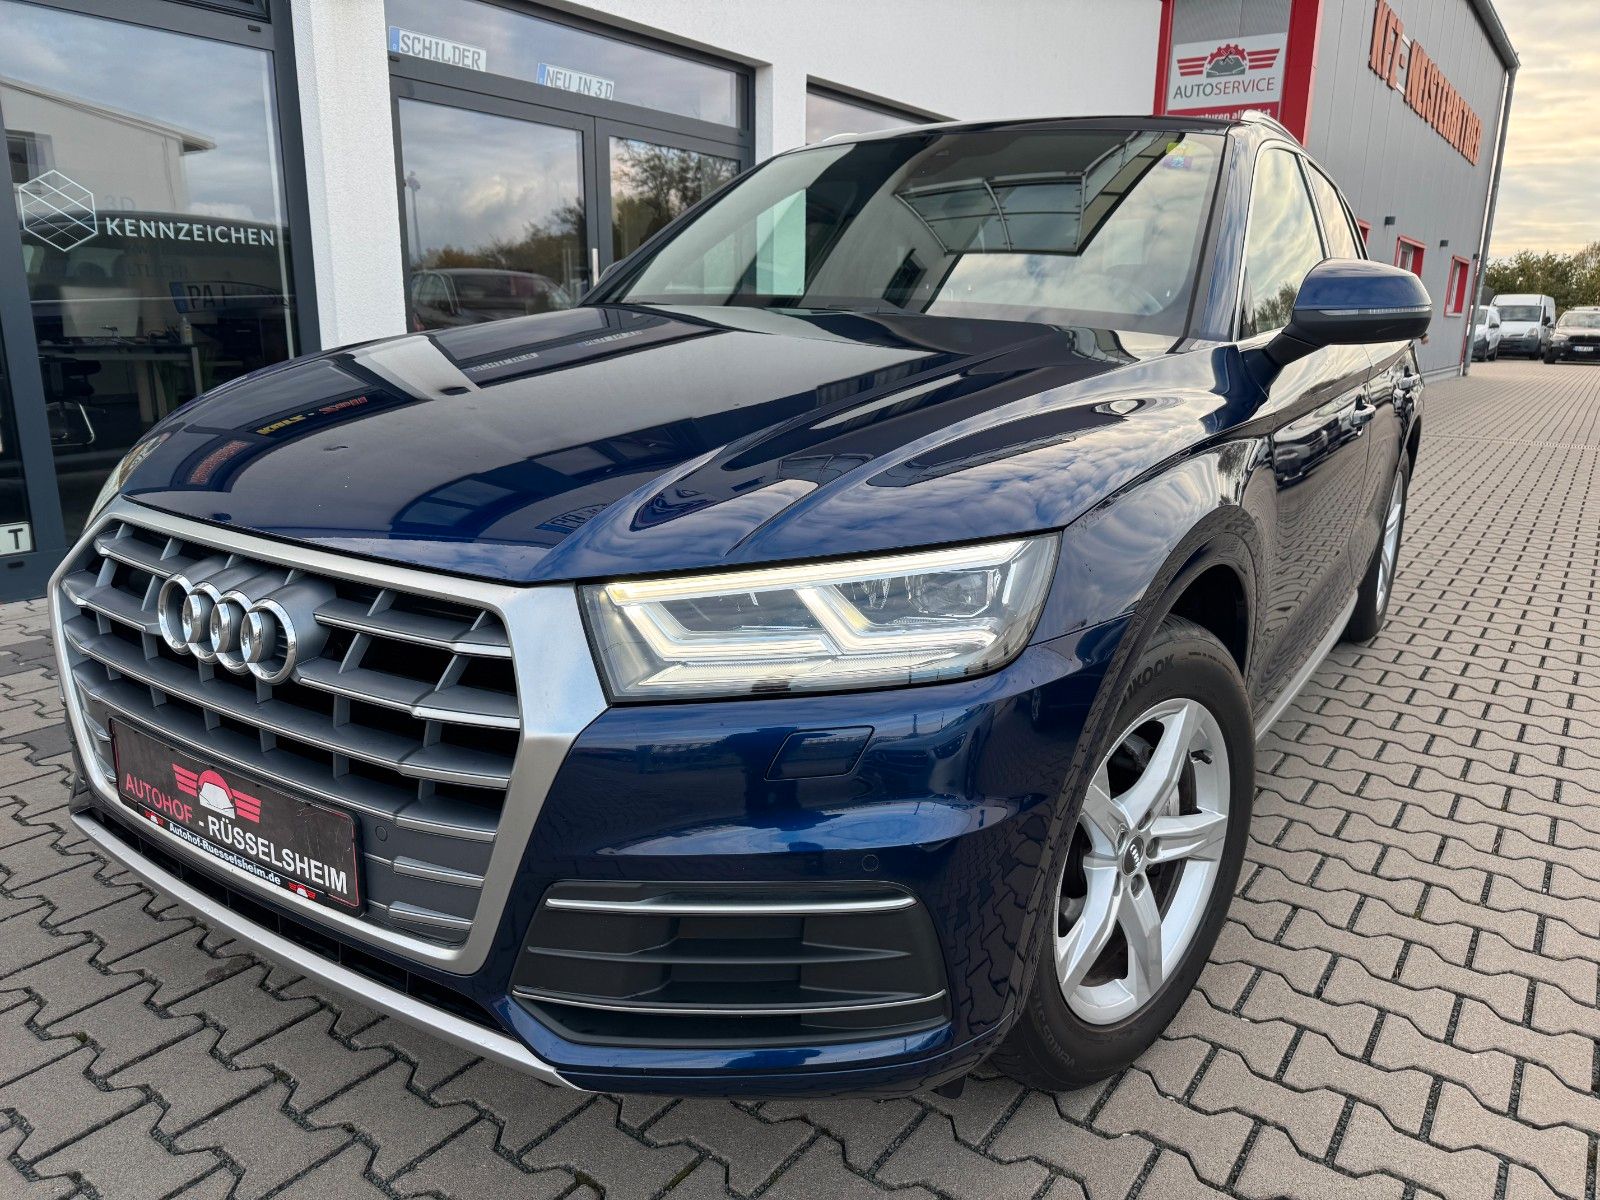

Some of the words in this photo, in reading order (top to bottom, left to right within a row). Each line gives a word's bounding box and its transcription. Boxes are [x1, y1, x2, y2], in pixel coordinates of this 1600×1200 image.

[400, 33, 480, 70] SCHILDER
[545, 68, 572, 89] NEU
[576, 75, 592, 94] IN
[1173, 77, 1275, 99] AUTOSERVICE
[105, 217, 275, 246] KENNZEICHEN
[125, 772, 193, 824] AUTOHOF
[208, 815, 348, 895] RÜSSELSHEIM
[168, 823, 281, 885] Autohof-Ruesselsheim.de
